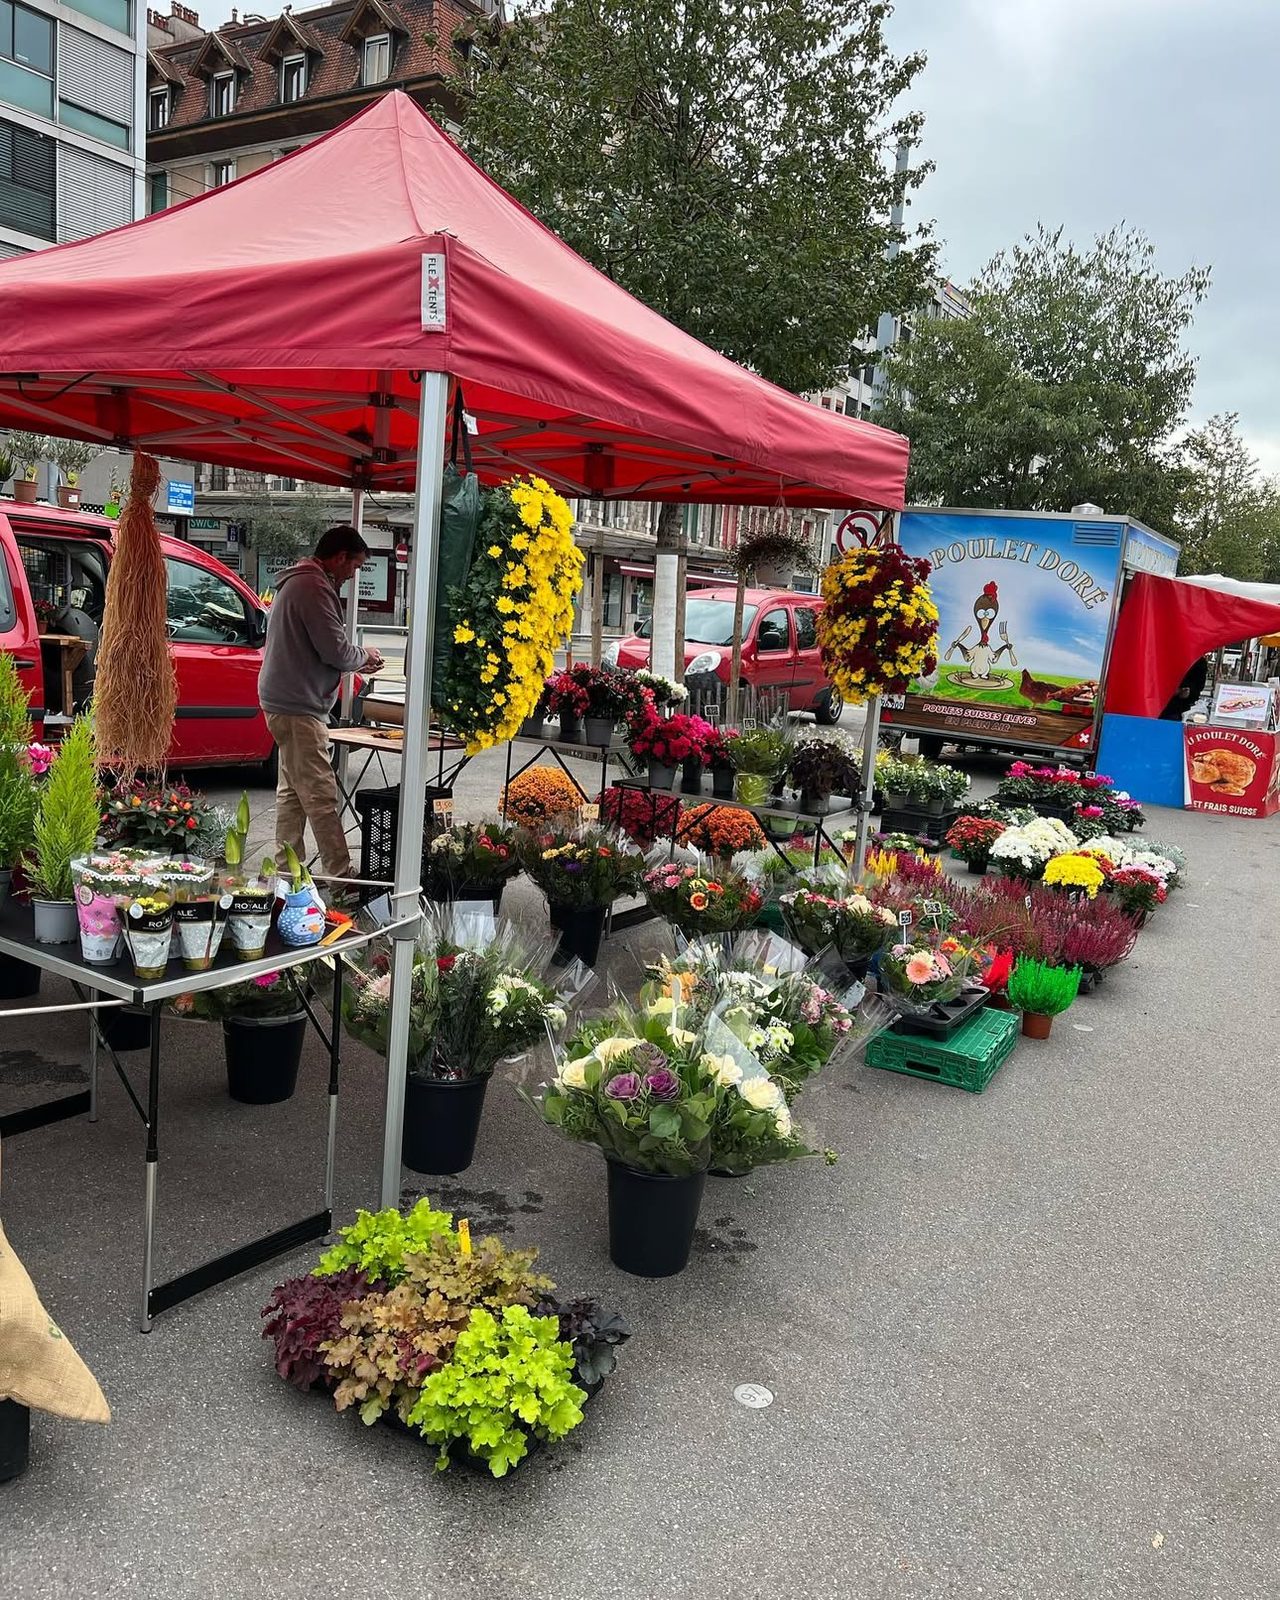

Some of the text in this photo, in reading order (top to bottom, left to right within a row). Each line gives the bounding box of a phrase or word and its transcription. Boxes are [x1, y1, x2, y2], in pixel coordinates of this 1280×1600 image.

[428, 257, 440, 320] FLEXTENTS
[929, 537, 1039, 570] POULET
[922, 703, 963, 716] POULETS
[963, 708, 1001, 721] SUISSES
[944, 716, 1011, 732] EN PLEIN AIR
[1187, 736, 1195, 745] U
[1195, 731, 1240, 741] POULET
[1193, 800, 1258, 816] ET FRAIS SUISSE
